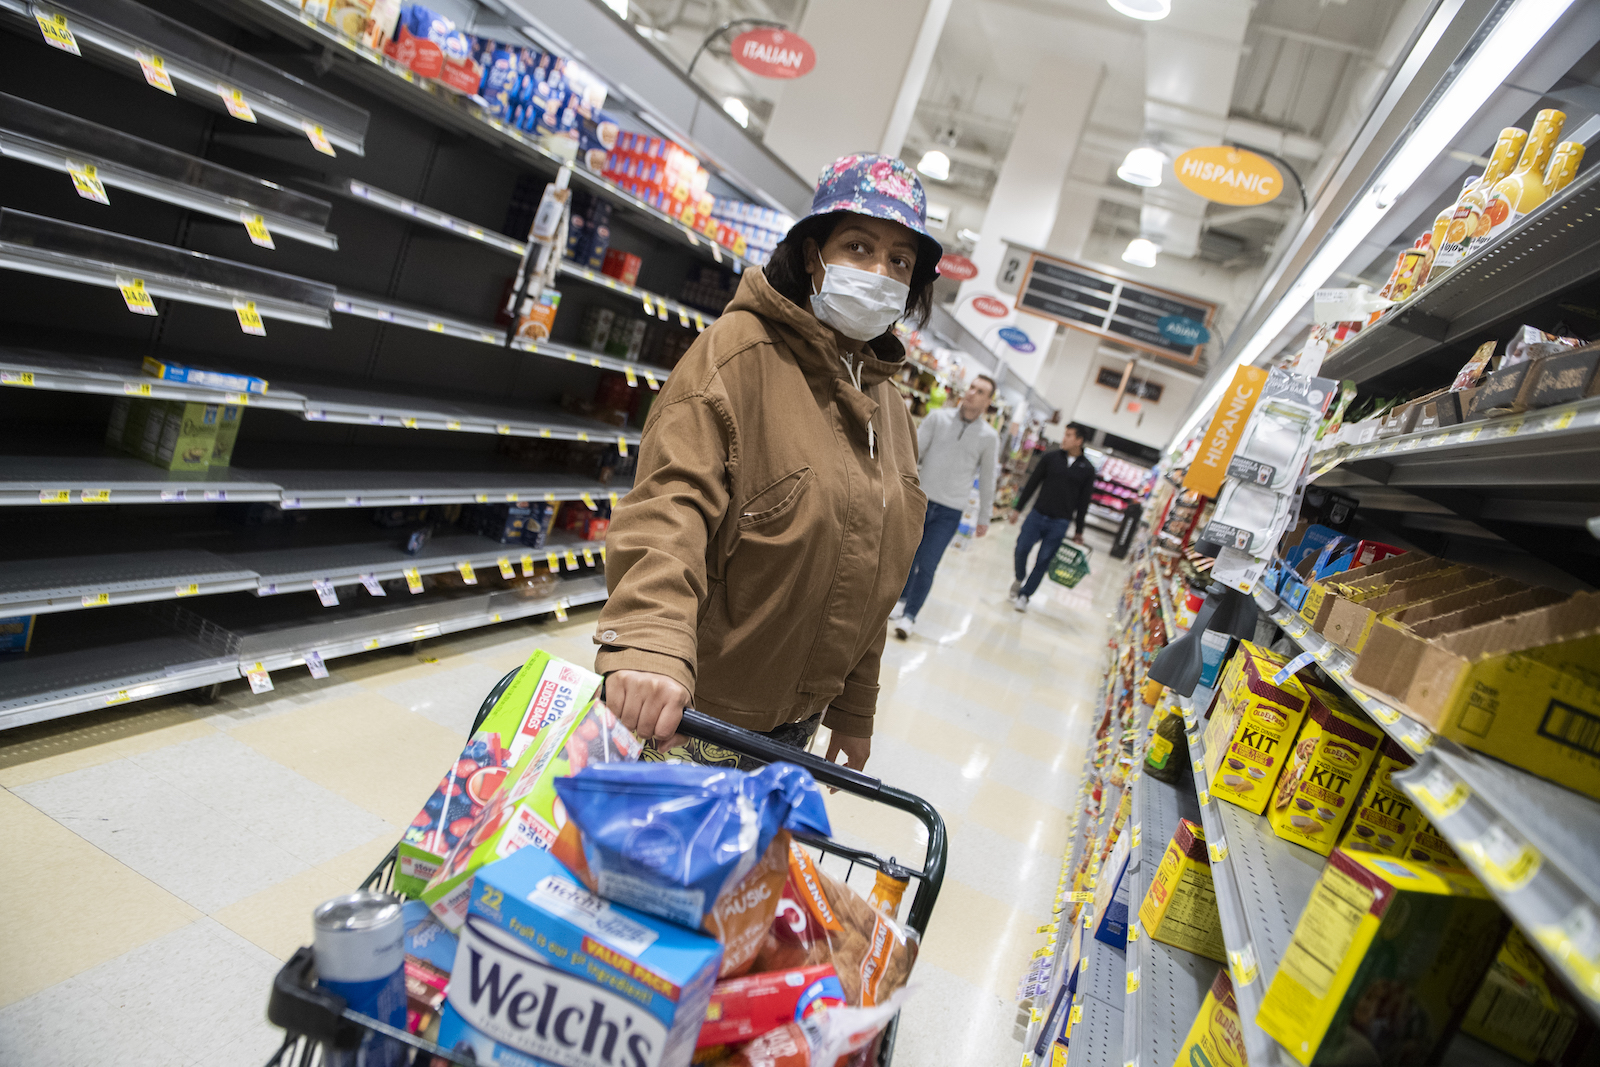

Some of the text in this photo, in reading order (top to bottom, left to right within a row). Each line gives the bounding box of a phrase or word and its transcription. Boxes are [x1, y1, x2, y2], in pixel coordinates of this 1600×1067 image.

[742, 39, 804, 70] ITALIAN
[1181, 157, 1274, 196] HISPANIC
[1165, 321, 1200, 341] ASIAN
[1202, 384, 1254, 468] HISPANIC
[526, 681, 557, 730] SLIDER BAGS
[540, 685, 573, 729] storag
[1239, 728, 1280, 754] KIT
[1246, 721, 1281, 742] TACO DINNER
[1309, 766, 1351, 794] KIT
[1316, 760, 1353, 780] TACO DINNER
[1370, 792, 1412, 820] KIT
[482, 885, 504, 911] 22
[803, 873, 833, 924] HONEY
[874, 924, 888, 960] WHEAT
[586, 939, 674, 998] VALUE PACK
[465, 943, 652, 1067] Welch's
